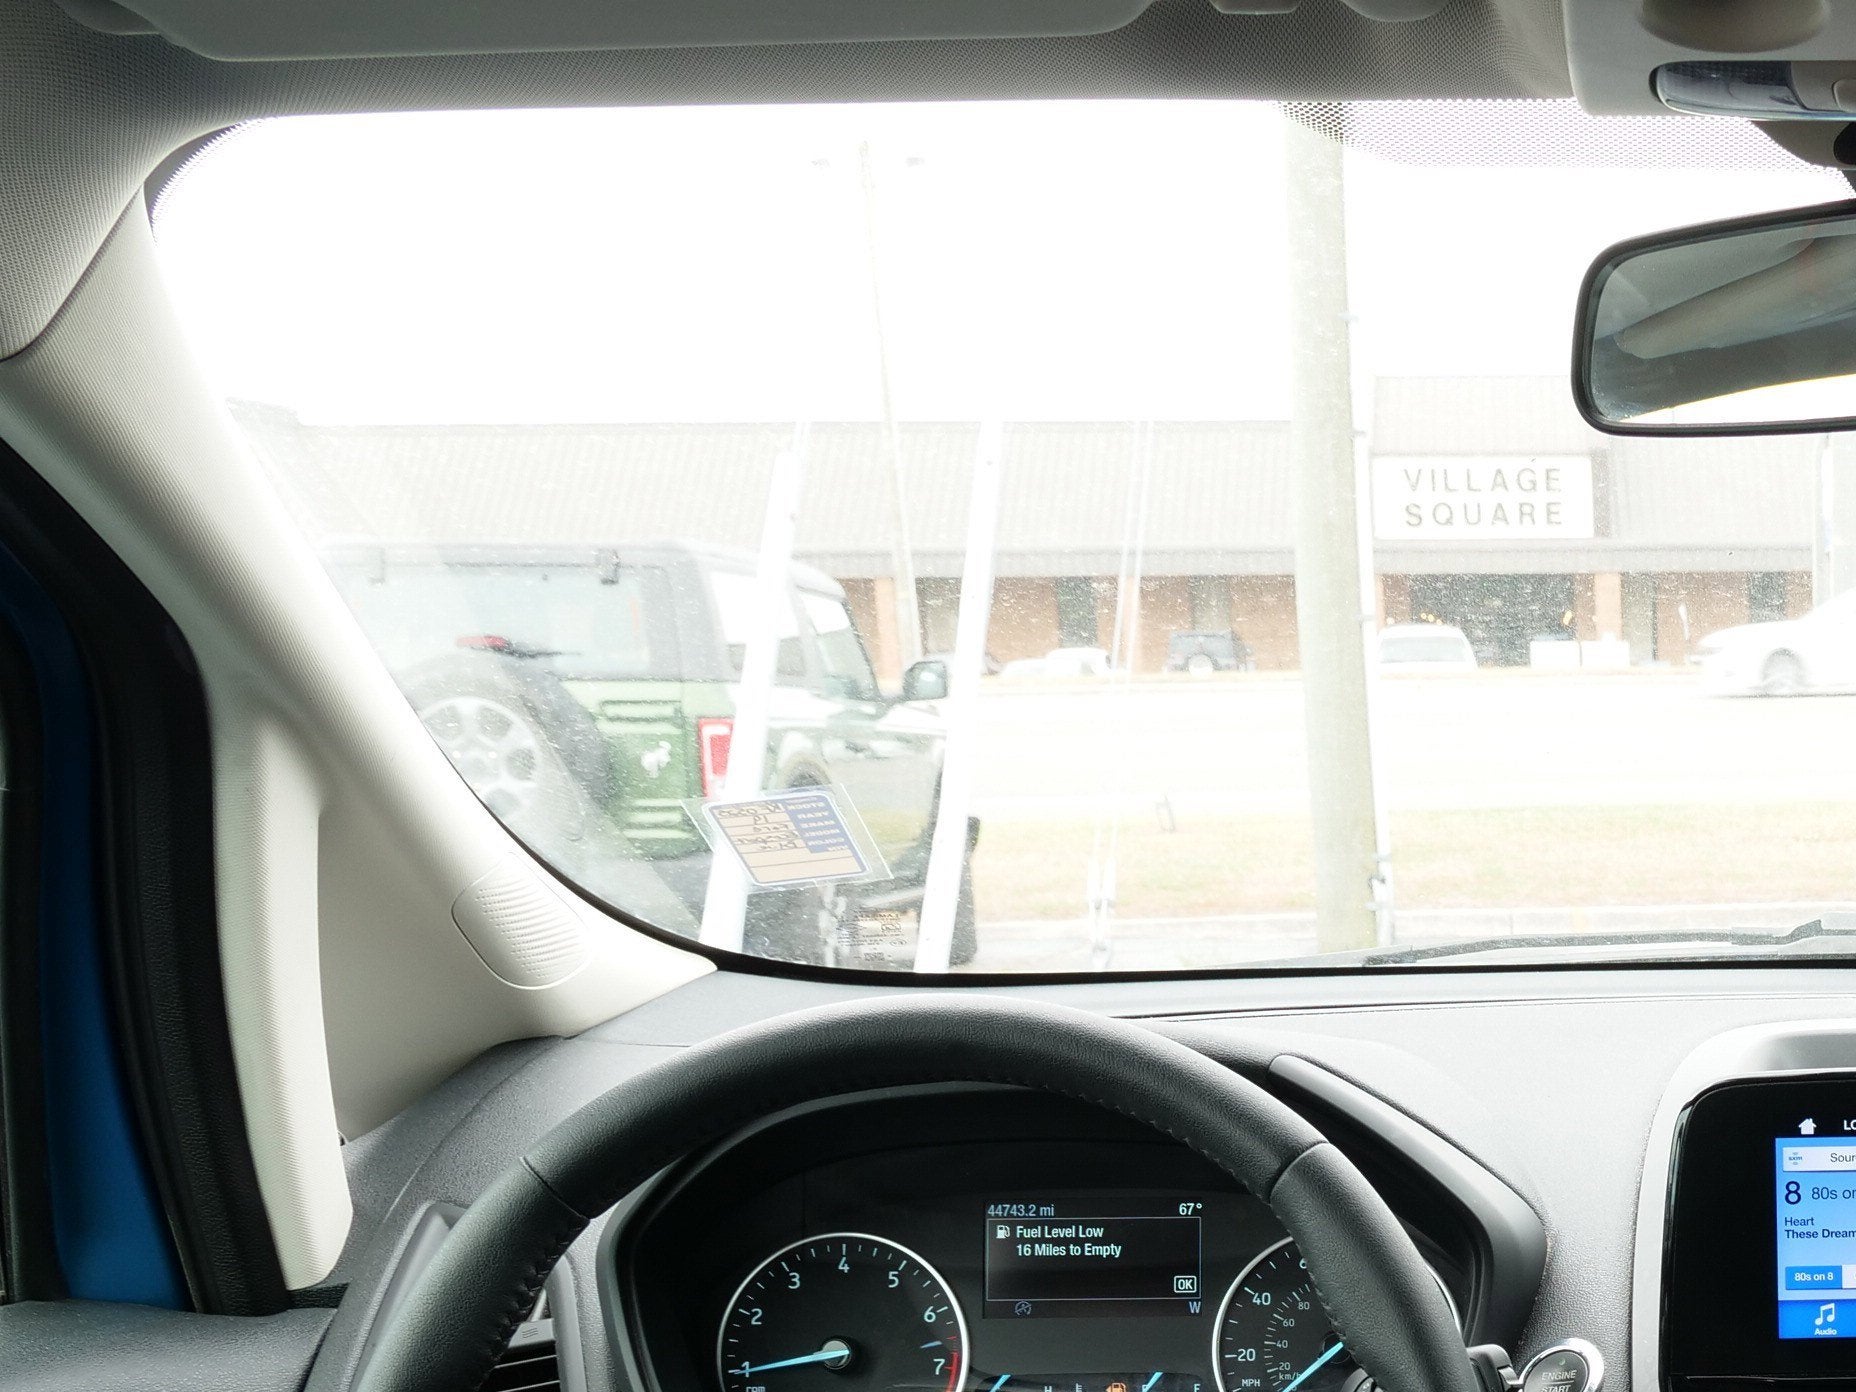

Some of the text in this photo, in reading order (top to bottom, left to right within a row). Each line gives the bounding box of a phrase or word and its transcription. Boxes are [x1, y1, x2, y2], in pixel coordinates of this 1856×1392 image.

[1403, 467, 1561, 493] VILLAGE
[1404, 502, 1562, 528] SQUARE
[1784, 1180, 1802, 1206] 8
[1811, 1186, 1838, 1200] 80s
[987, 1204, 1055, 1217] 44743.2 mi
[1178, 1202, 1203, 1216] 67°
[1784, 1216, 1815, 1227] Heart
[1016, 1225, 1104, 1239] Fuel Level Low
[1784, 1229, 1819, 1240] These
[1016, 1243, 1122, 1259] 16 Miles to Empty
[838, 1257, 850, 1273] 4
[788, 1272, 801, 1289] 3
[888, 1270, 899, 1288] 5
[1794, 1271, 1834, 1282] 80s on 8
[1177, 1279, 1193, 1290] OK
[1252, 1292, 1271, 1306] 40
[1188, 1301, 1201, 1314] W
[1298, 1302, 1310, 1310] 80
[750, 1308, 763, 1325] 2
[923, 1306, 936, 1323] 6
[1282, 1318, 1295, 1327] 60
[1814, 1327, 1837, 1336] Audio
[1276, 1340, 1288, 1349] 40
[1237, 1349, 1256, 1361] 20
[741, 1361, 751, 1378] 1
[933, 1358, 945, 1375] 7
[1279, 1362, 1291, 1371] 20
[1541, 1369, 1578, 1381] ENGINE
[1241, 1379, 1261, 1388] MPH
